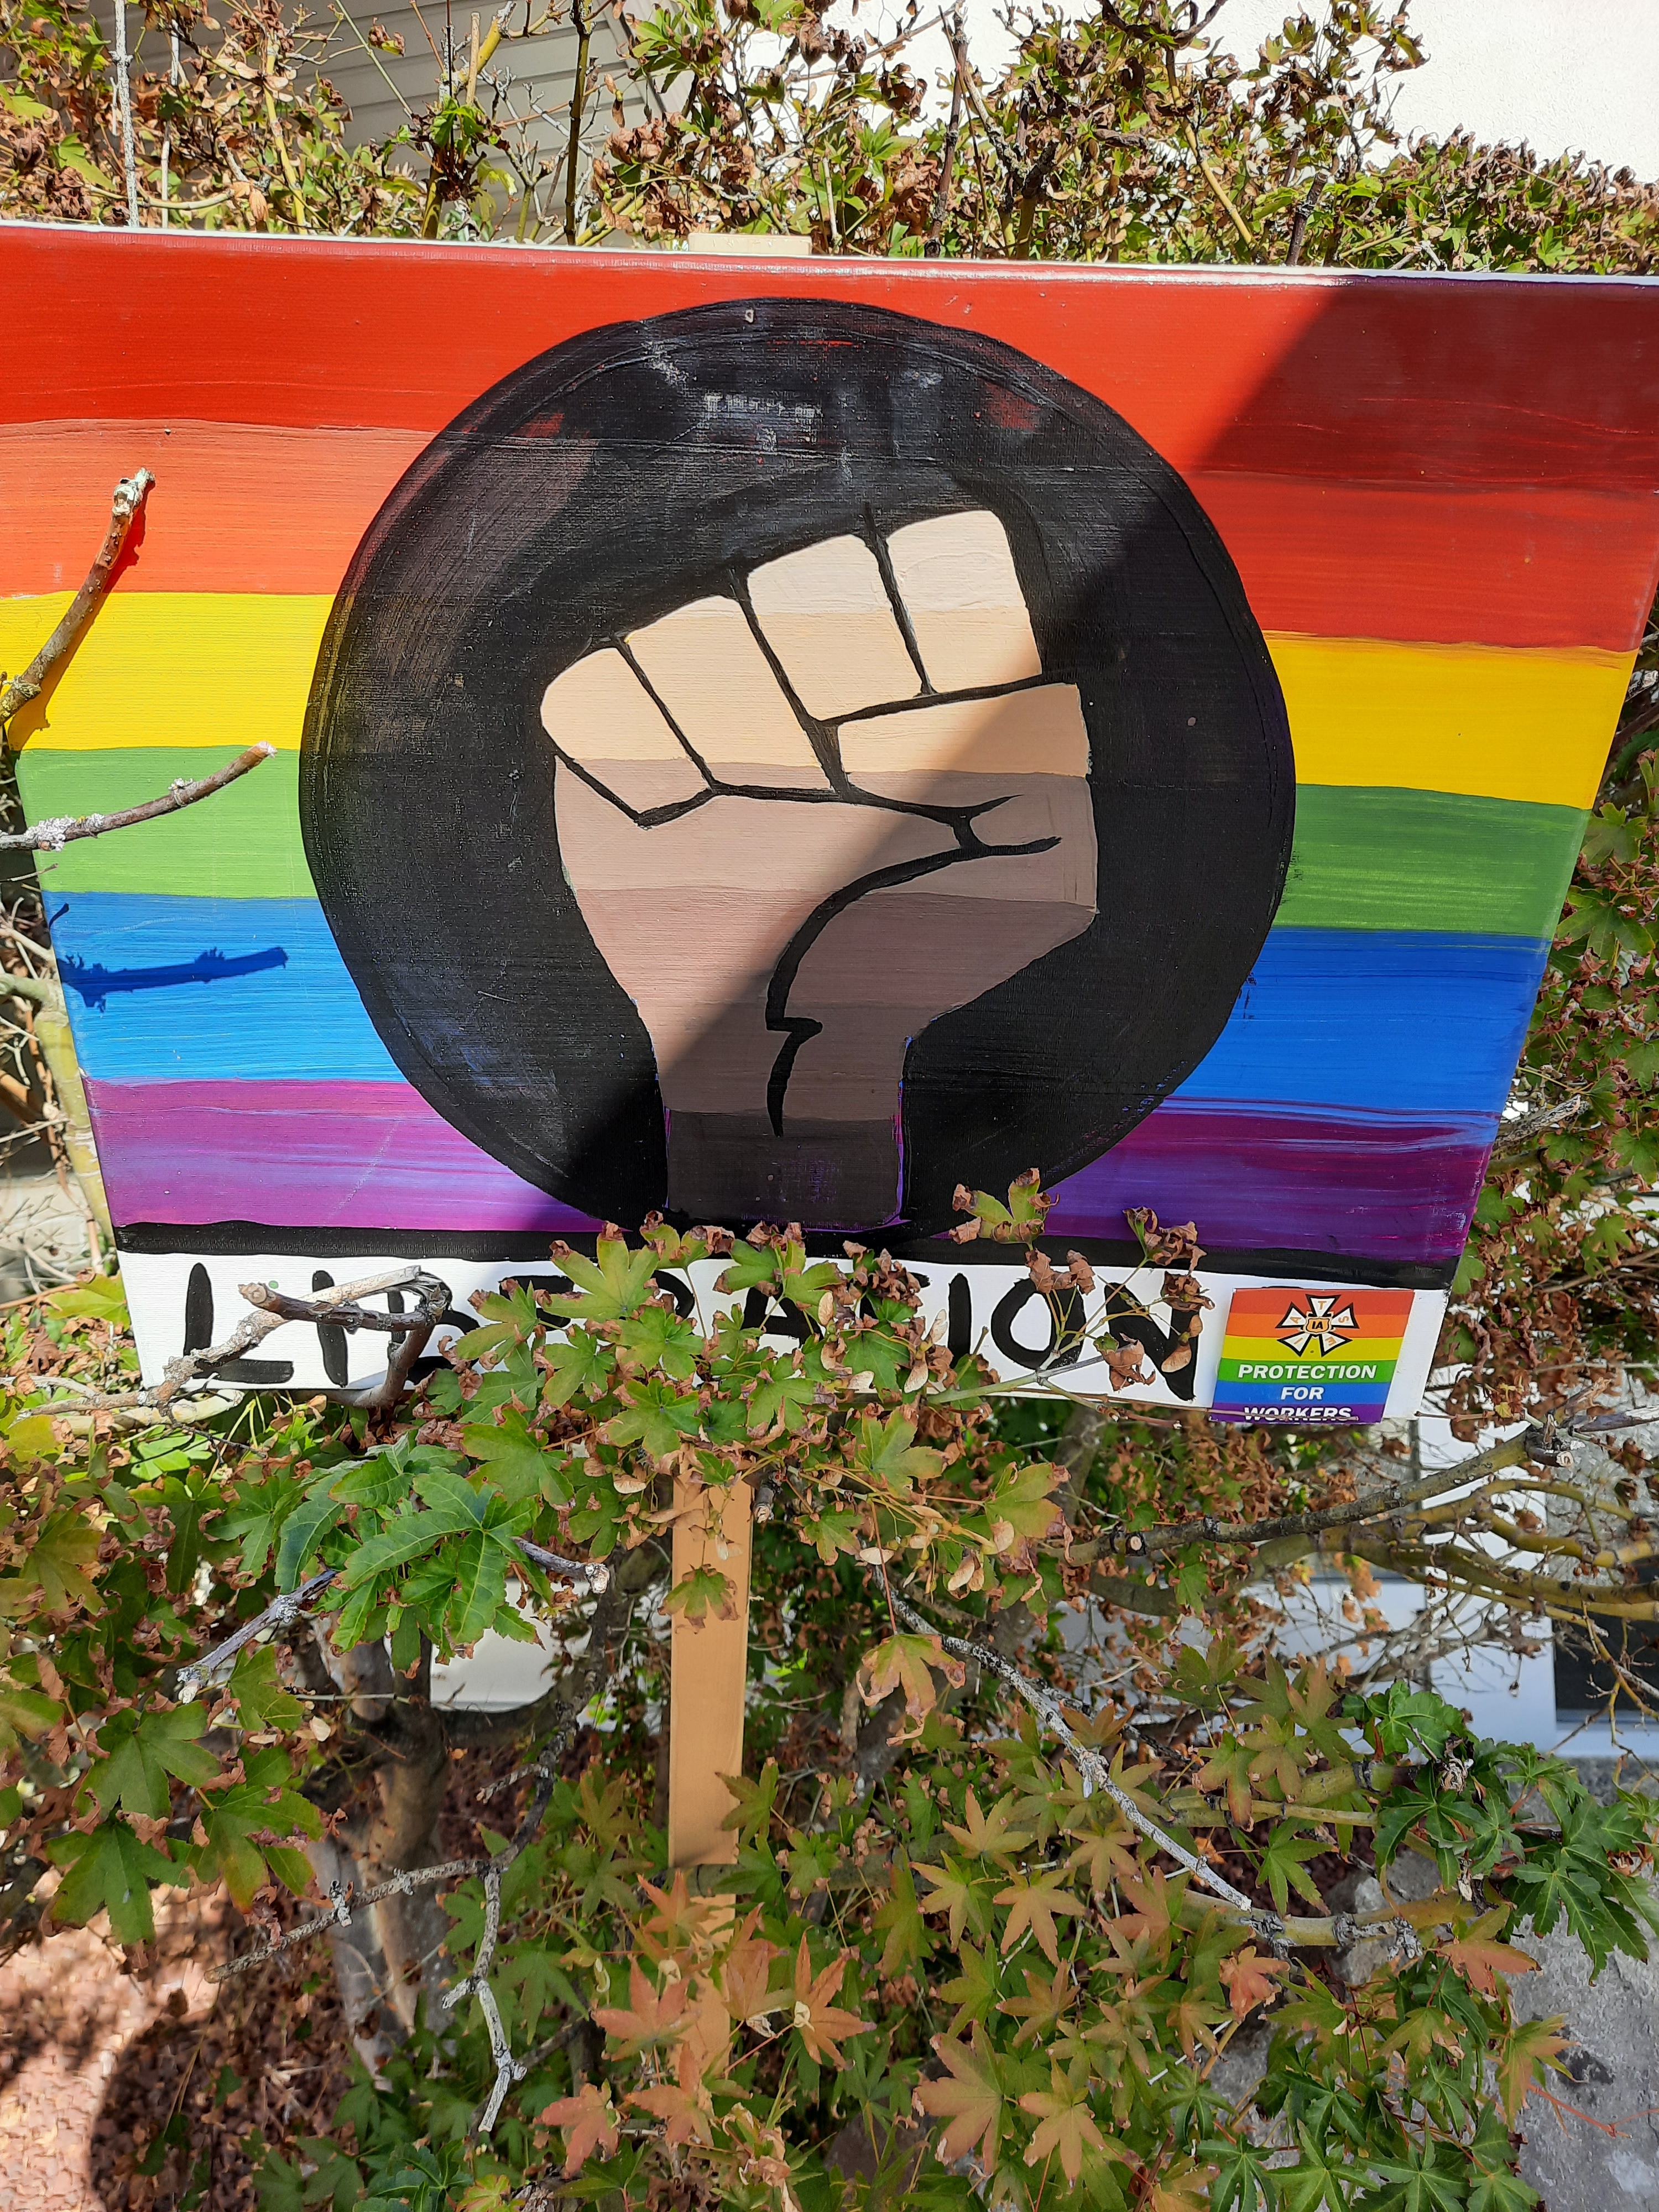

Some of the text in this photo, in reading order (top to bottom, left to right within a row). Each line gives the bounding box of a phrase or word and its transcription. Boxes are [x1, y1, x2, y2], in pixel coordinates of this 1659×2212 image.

[184, 1262, 1201, 1401] LIAION
[1312, 1321, 1323, 1329] IA
[1238, 1364, 1377, 1379] PROTECTION
[1281, 1386, 1324, 1400] FOR
[1244, 1407, 1352, 1421] WORKERS
